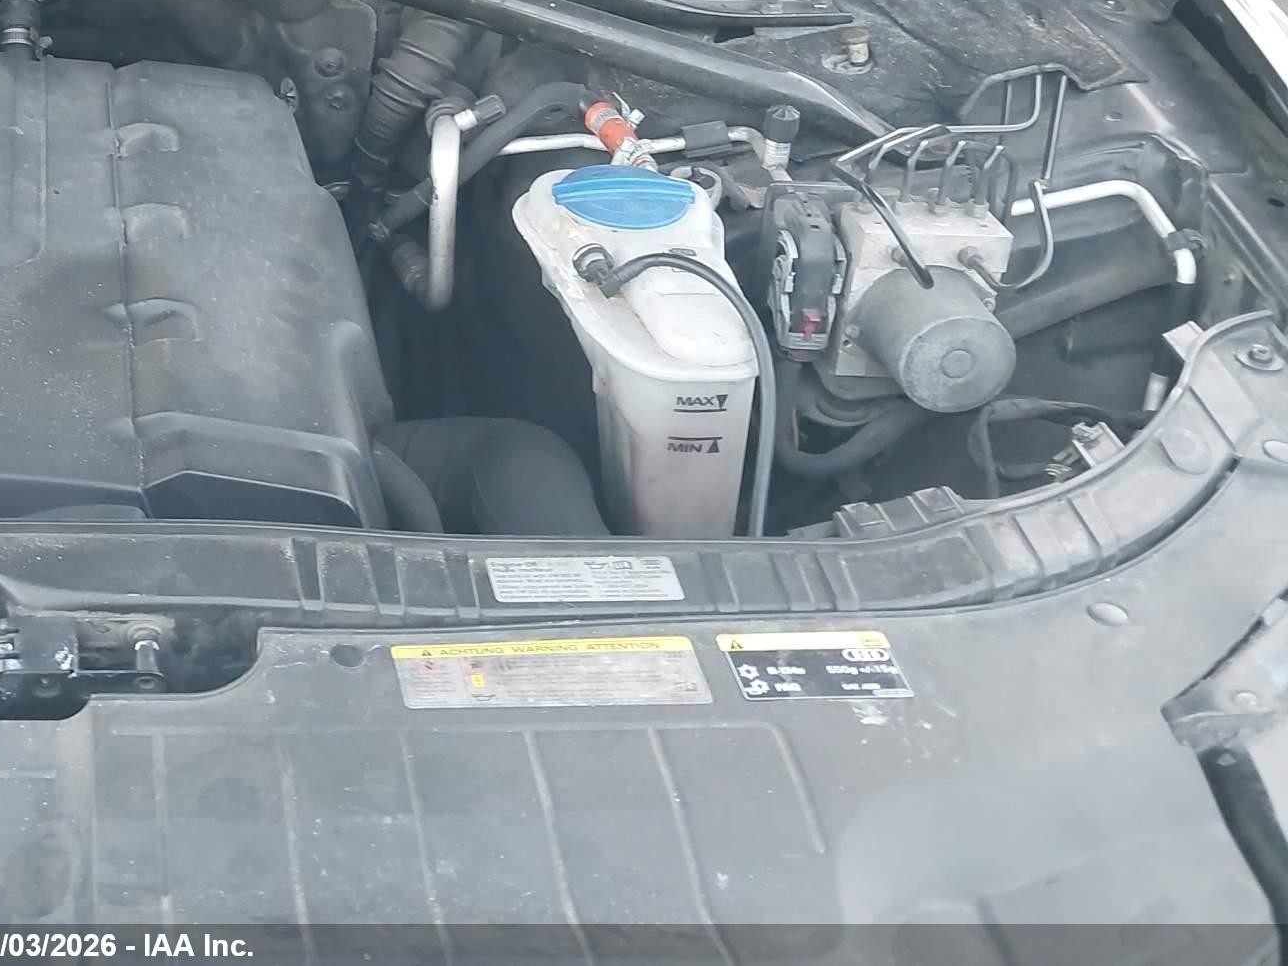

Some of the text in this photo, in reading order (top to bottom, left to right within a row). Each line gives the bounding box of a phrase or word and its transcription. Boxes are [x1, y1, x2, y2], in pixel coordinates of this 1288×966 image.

[676, 396, 714, 406] MAX
[667, 442, 702, 453] MIN
[440, 641, 661, 656] ACHTUNG WARNING ATTENTION
